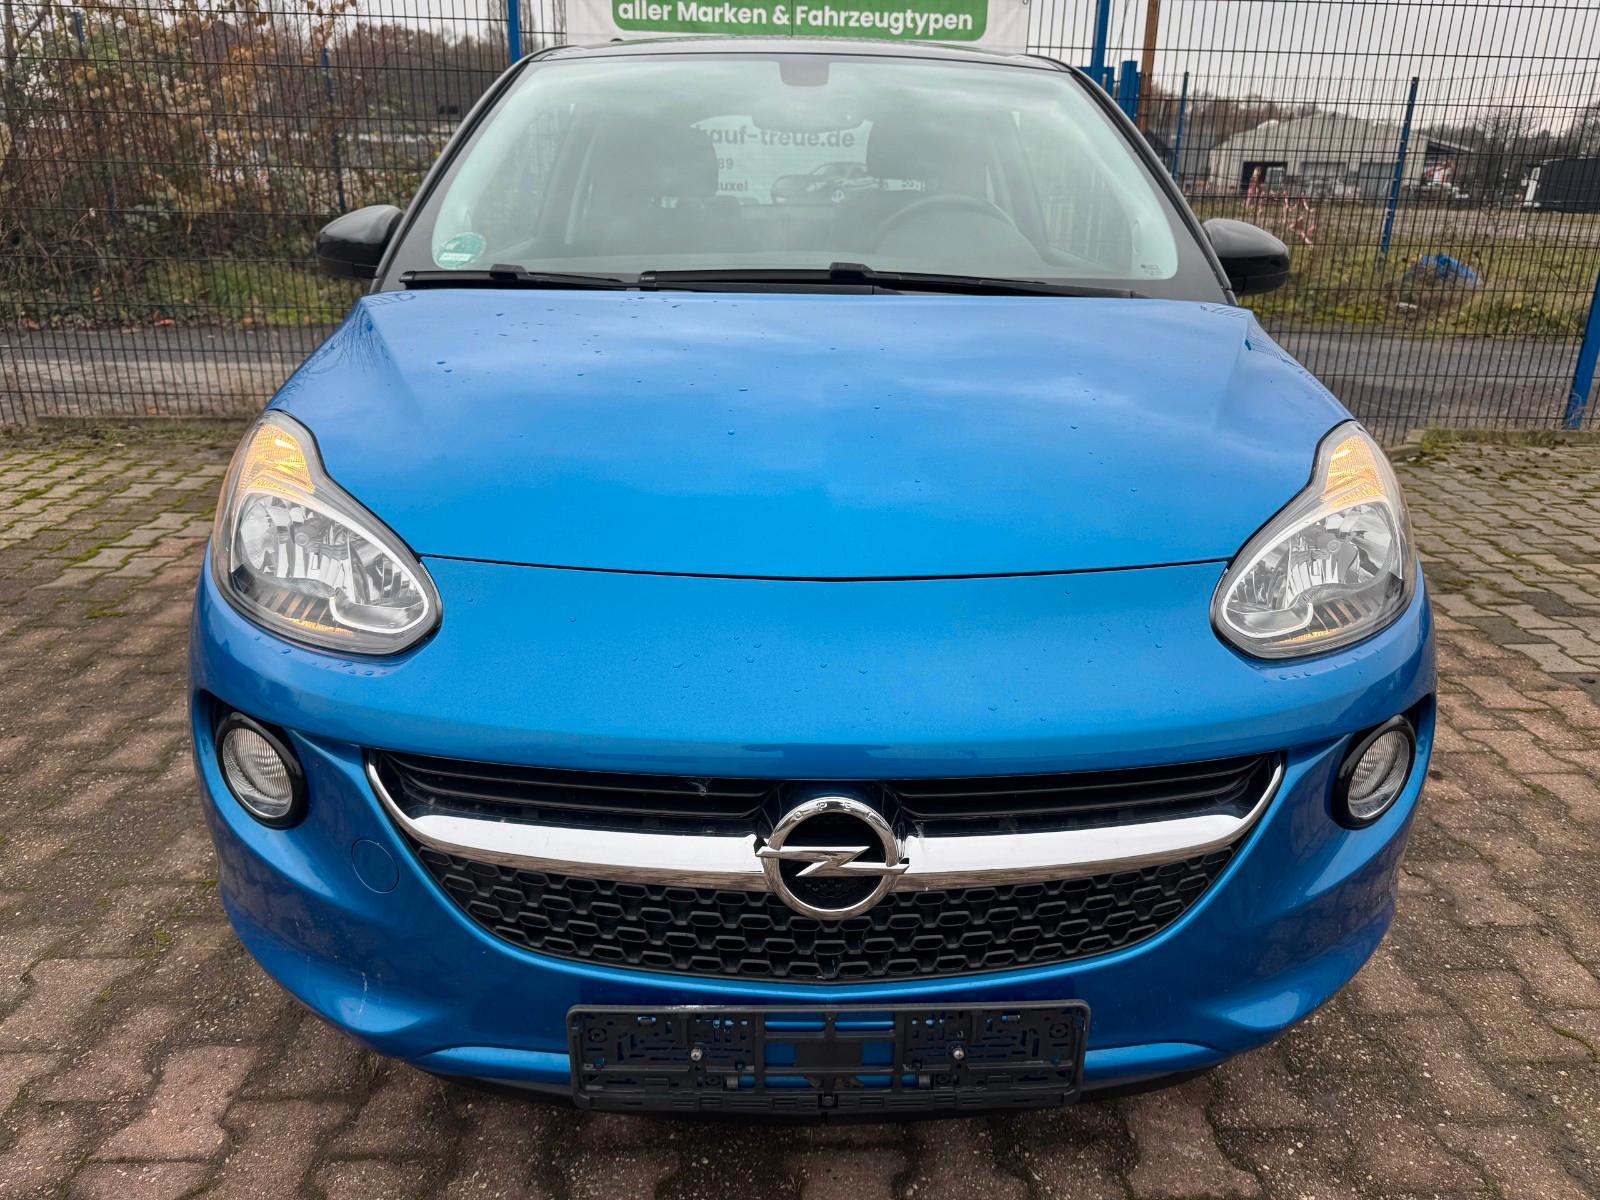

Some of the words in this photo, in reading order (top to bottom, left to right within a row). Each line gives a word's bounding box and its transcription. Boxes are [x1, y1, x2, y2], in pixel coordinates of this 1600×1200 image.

[618, 0, 672, 21] aller
[677, 2, 767, 25] Marken
[772, 5, 791, 26] &
[796, 5, 973, 36] Fahrzeugtypen
